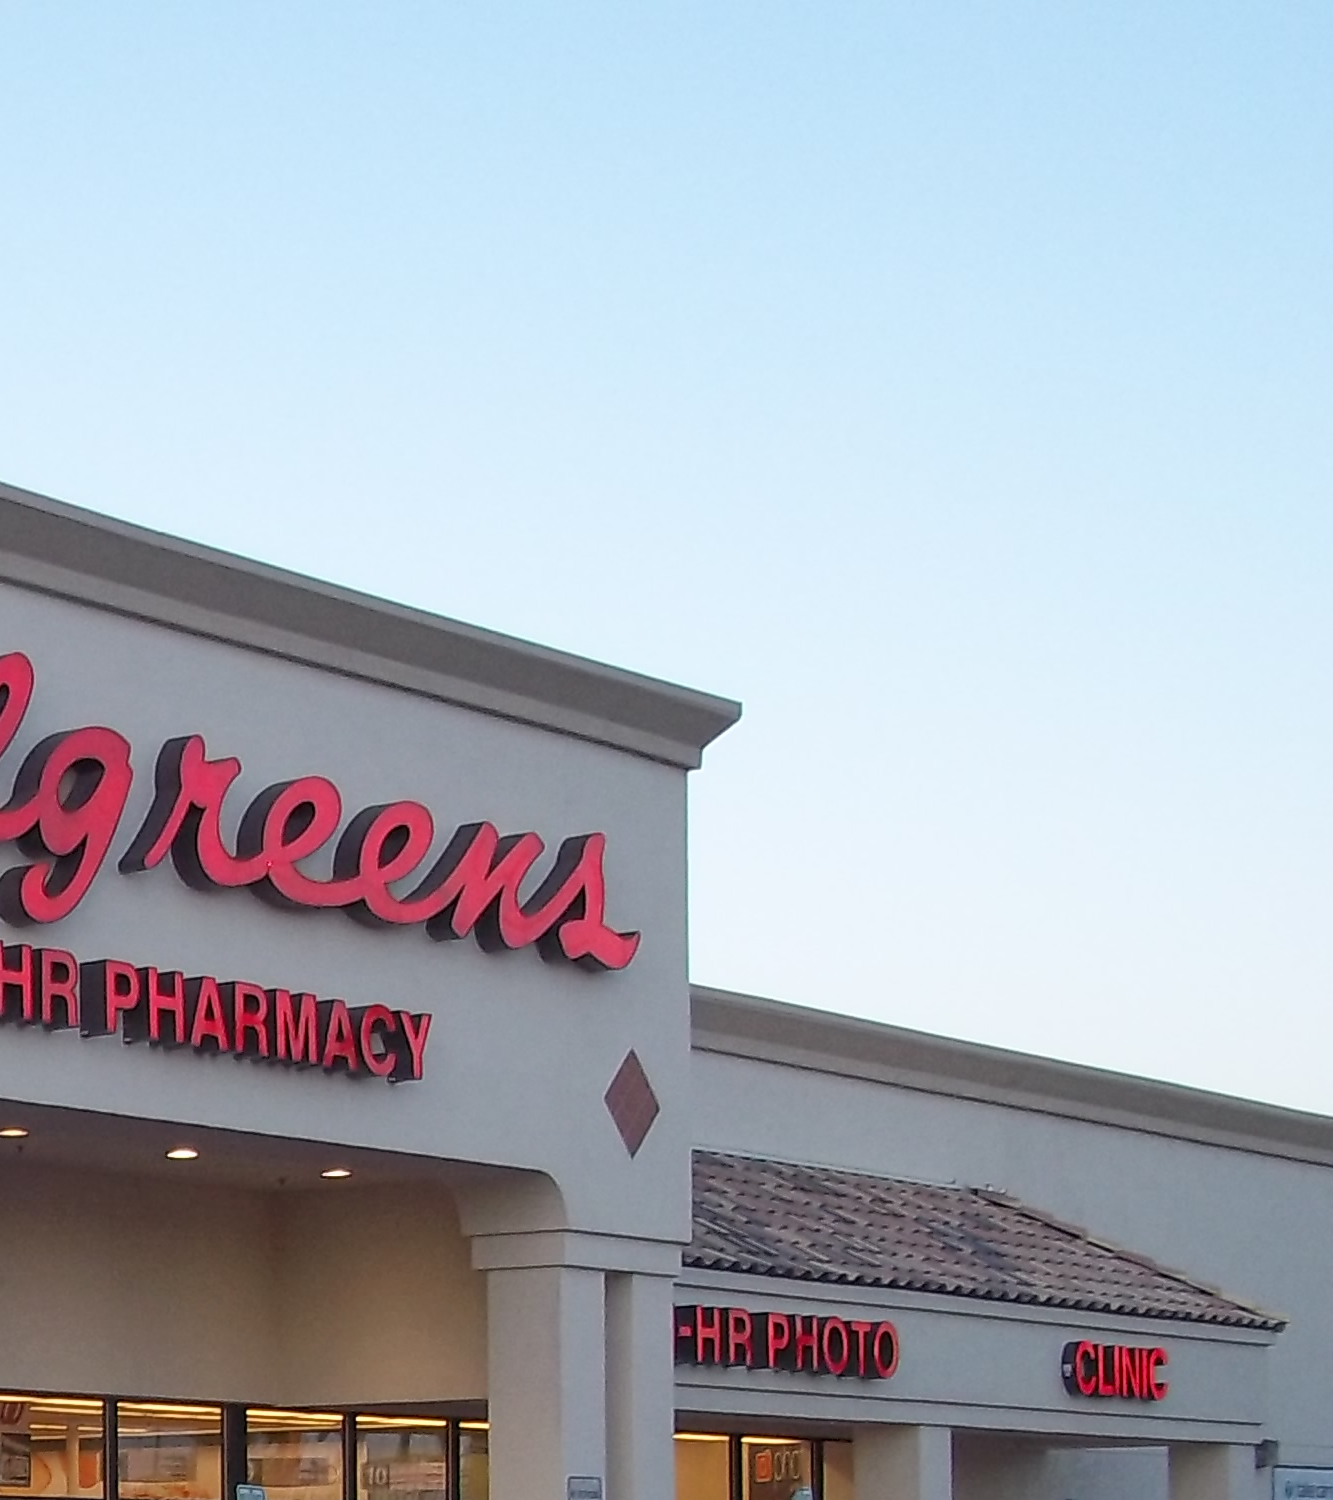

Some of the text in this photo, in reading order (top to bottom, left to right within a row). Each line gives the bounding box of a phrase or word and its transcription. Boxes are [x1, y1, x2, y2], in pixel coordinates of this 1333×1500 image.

[101, 960, 432, 1081] PHARMACY
[767, 1312, 900, 1379] PHOTO
[1075, 1340, 1168, 1401] CLINIC
